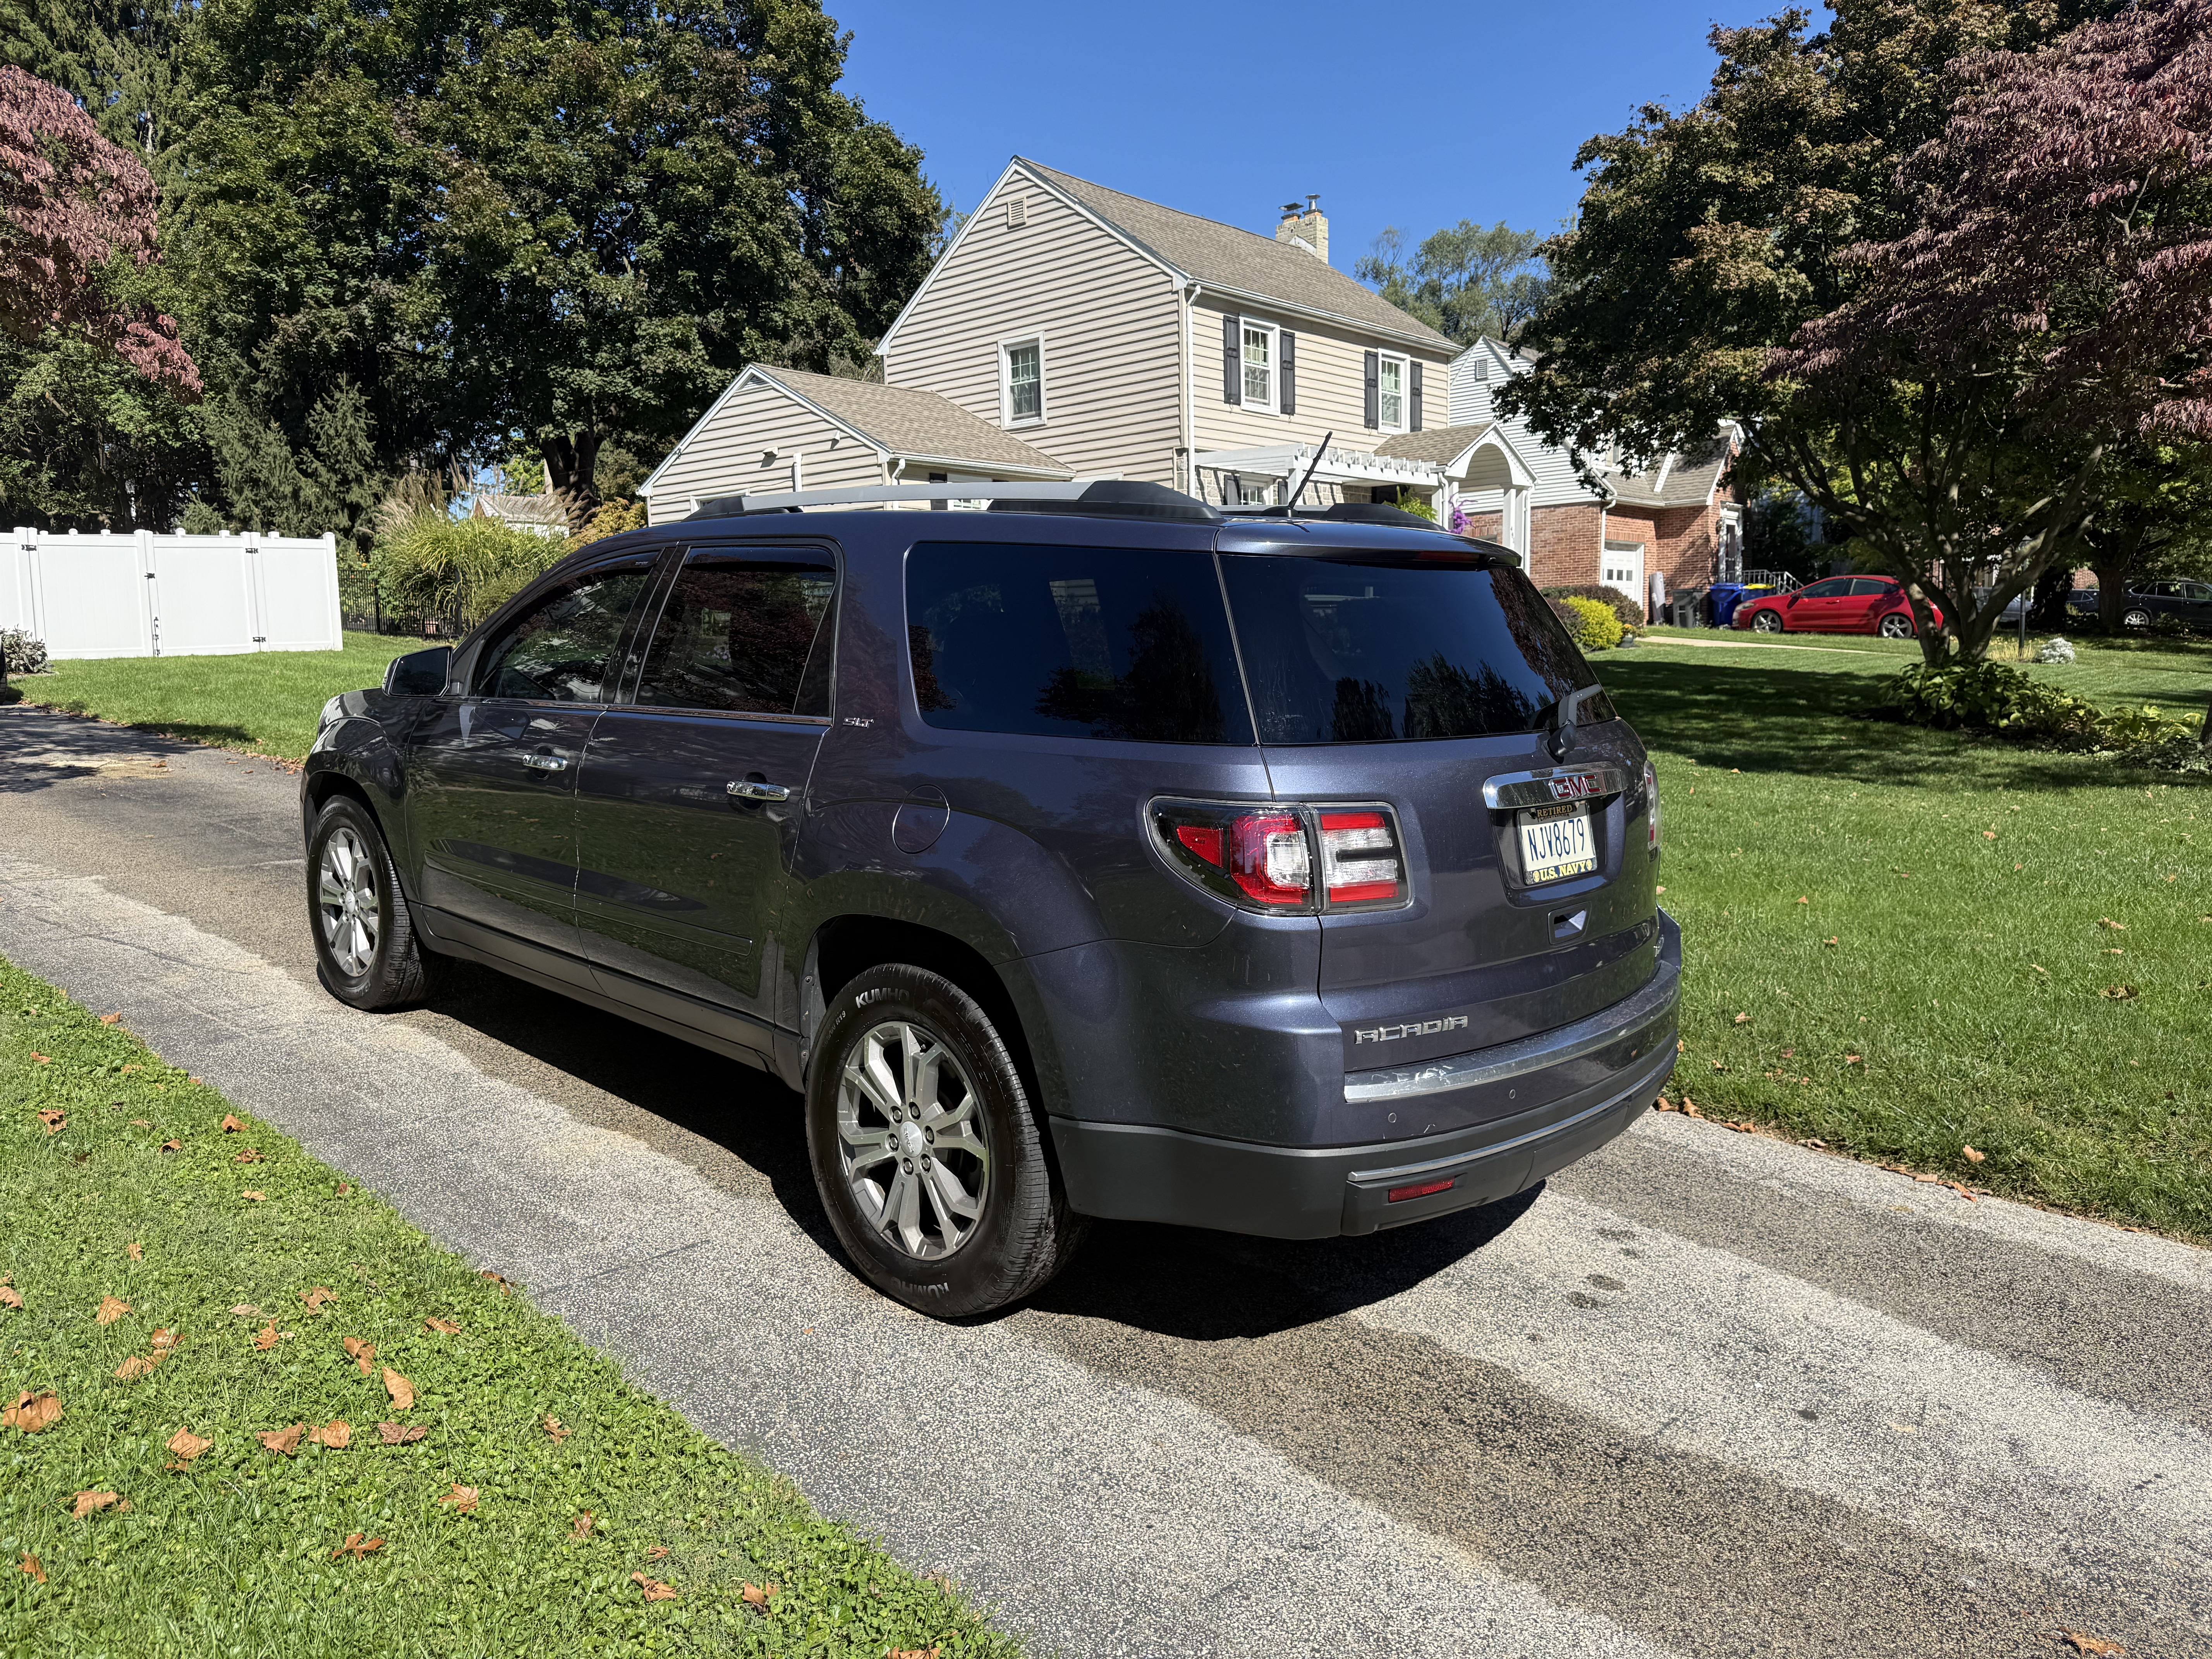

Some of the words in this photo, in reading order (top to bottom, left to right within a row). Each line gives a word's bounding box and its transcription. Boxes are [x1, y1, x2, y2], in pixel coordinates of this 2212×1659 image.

[843, 717, 874, 728] SLT
[1549, 774, 1601, 800] GMC
[1537, 804, 1573, 817] RETIRED
[1527, 818, 1584, 861] NJV8679
[1539, 867, 1558, 881] U.S.
[1559, 860, 1586, 877] NAVY
[855, 988, 910, 1008] KUMHO
[1354, 1014, 1468, 1044] ACADIA
